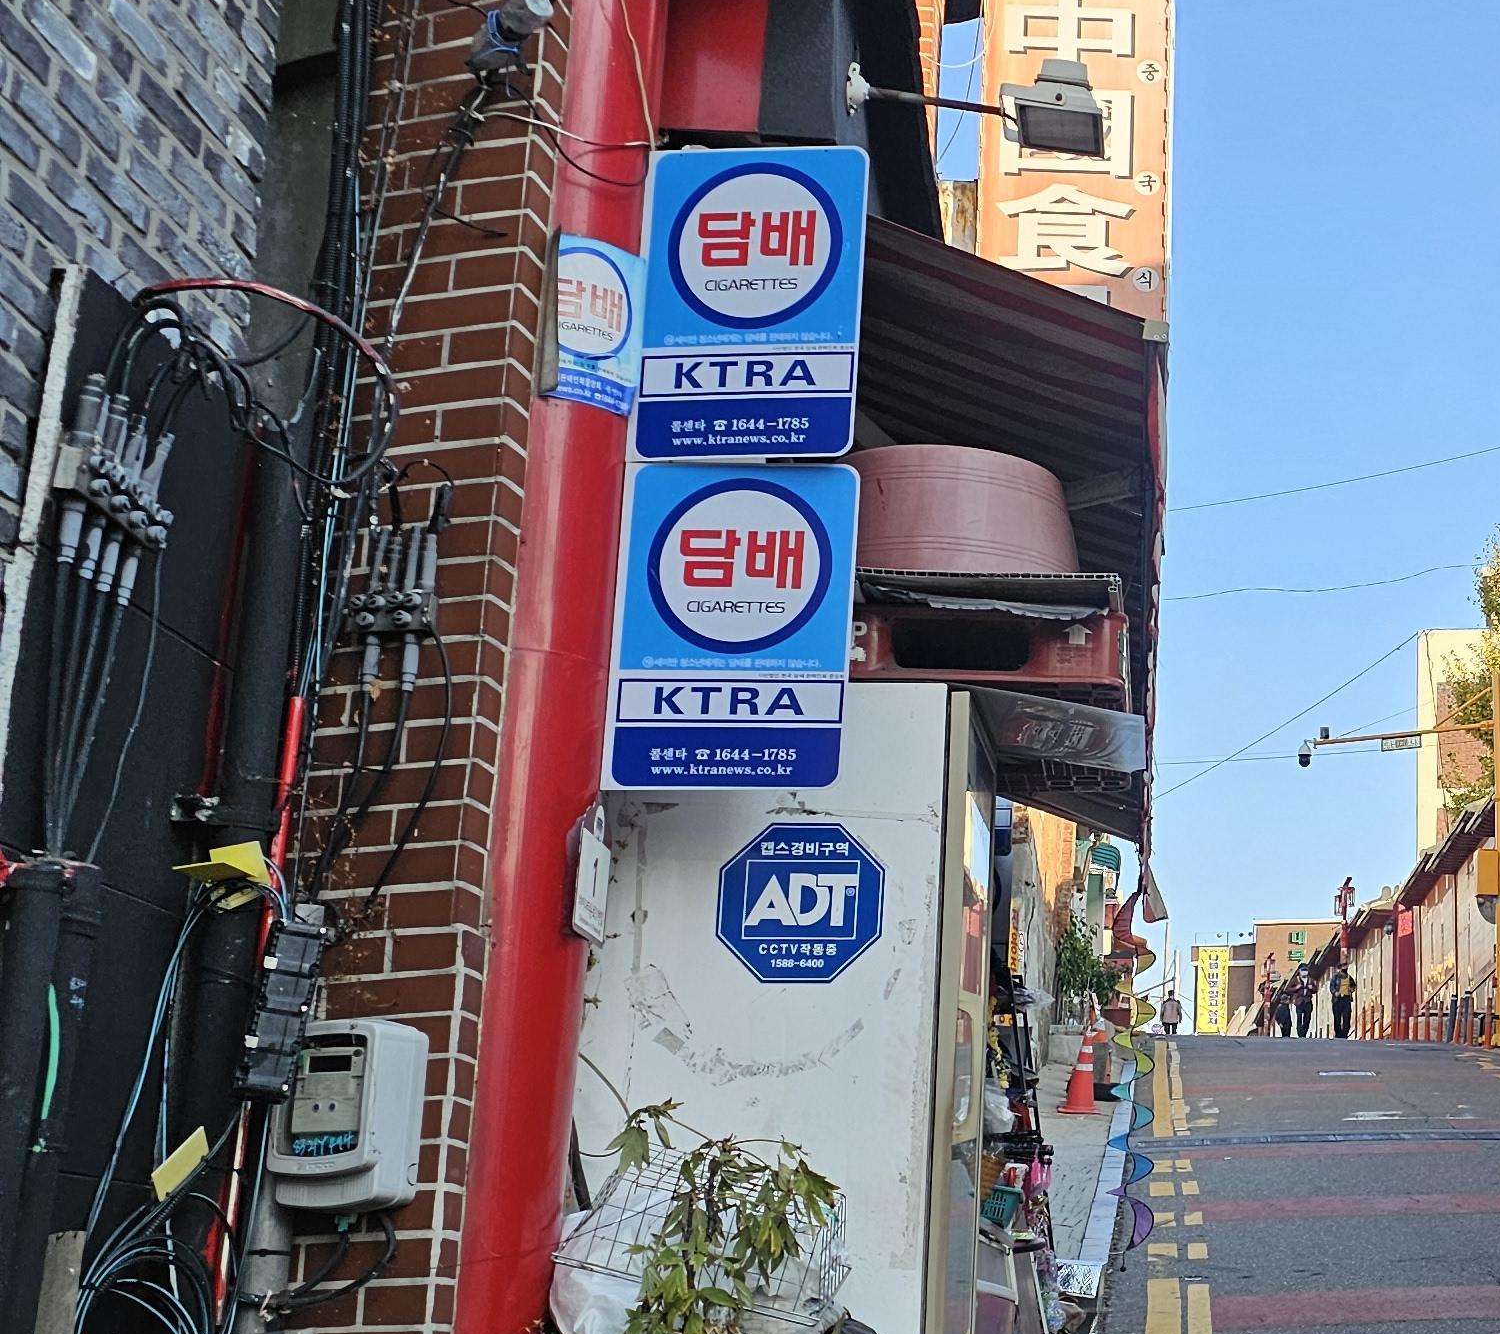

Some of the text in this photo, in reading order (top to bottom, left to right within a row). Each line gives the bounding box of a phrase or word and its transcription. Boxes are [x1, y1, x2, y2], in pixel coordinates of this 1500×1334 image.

[698, 209, 817, 267] 담배
[704, 277, 798, 292] CIGARETTES
[559, 321, 614, 342] IGARETTES
[674, 359, 817, 390] KTRA
[731, 417, 810, 431] 1644-1785
[671, 431, 807, 446] www.ktranews.co.kr
[679, 529, 806, 590] 담배
[686, 600, 786, 614] CIGARETTES
[653, 686, 805, 716] KTRA
[714, 748, 797, 761] 1644-1785
[650, 763, 793, 776] www.ktranews.co.kr
[761, 841, 850, 857] 캡스경비구역
[743, 873, 858, 927] ADT
[758, 943, 837, 956] CCTV작동중
[770, 958, 825, 969] 1588-6400
